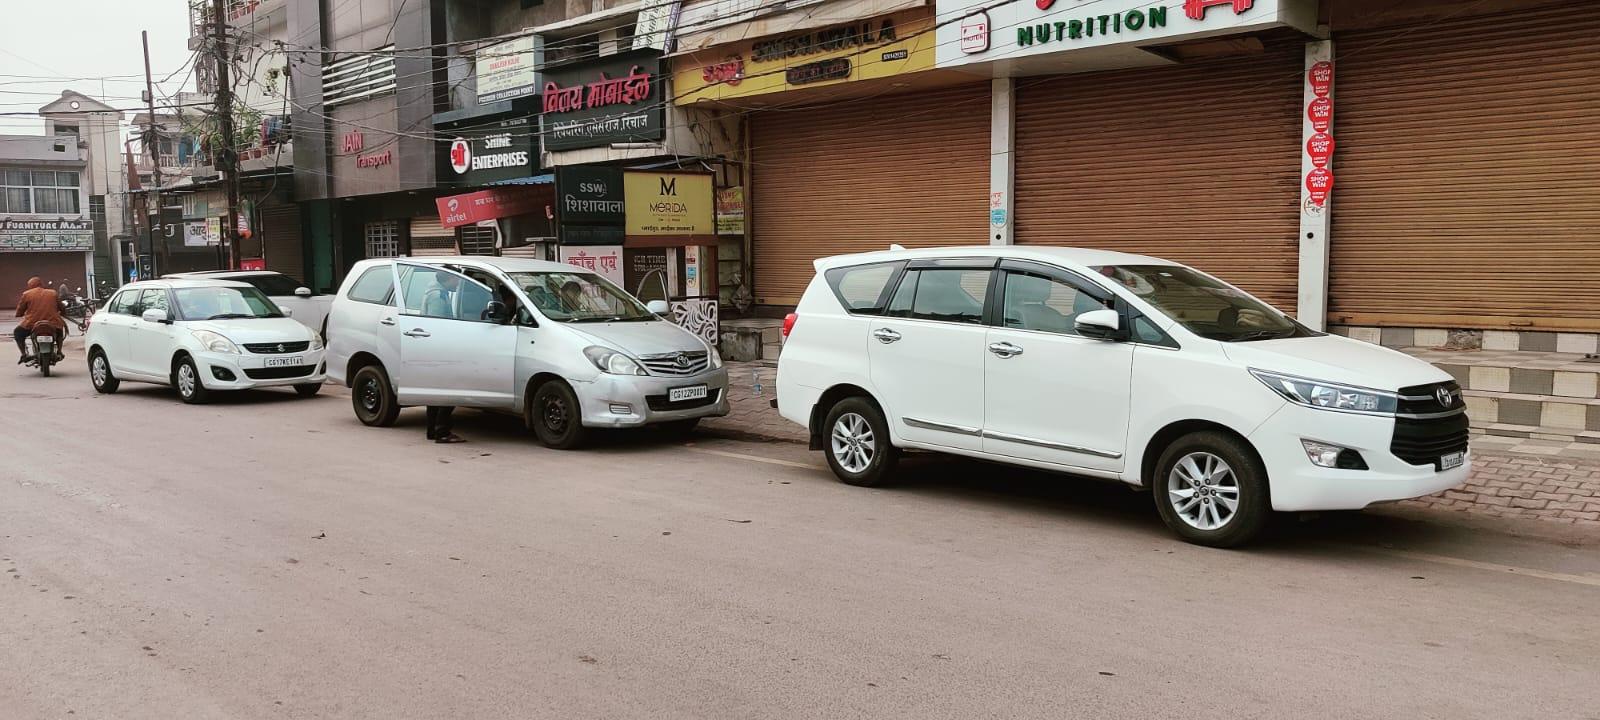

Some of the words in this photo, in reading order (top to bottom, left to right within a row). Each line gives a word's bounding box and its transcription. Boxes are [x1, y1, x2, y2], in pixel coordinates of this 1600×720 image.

[1017, 6, 1166, 46] NUTRITION
[342, 131, 363, 152] JAIN
[485, 133, 512, 149] SHINE
[357, 151, 392, 169] Transport
[472, 152, 529, 170] ENTERPRISES
[580, 182, 603, 193] SSW
[659, 177, 677, 196] M
[566, 194, 624, 213] शिशावाला
[446, 213, 466, 224] airtel
